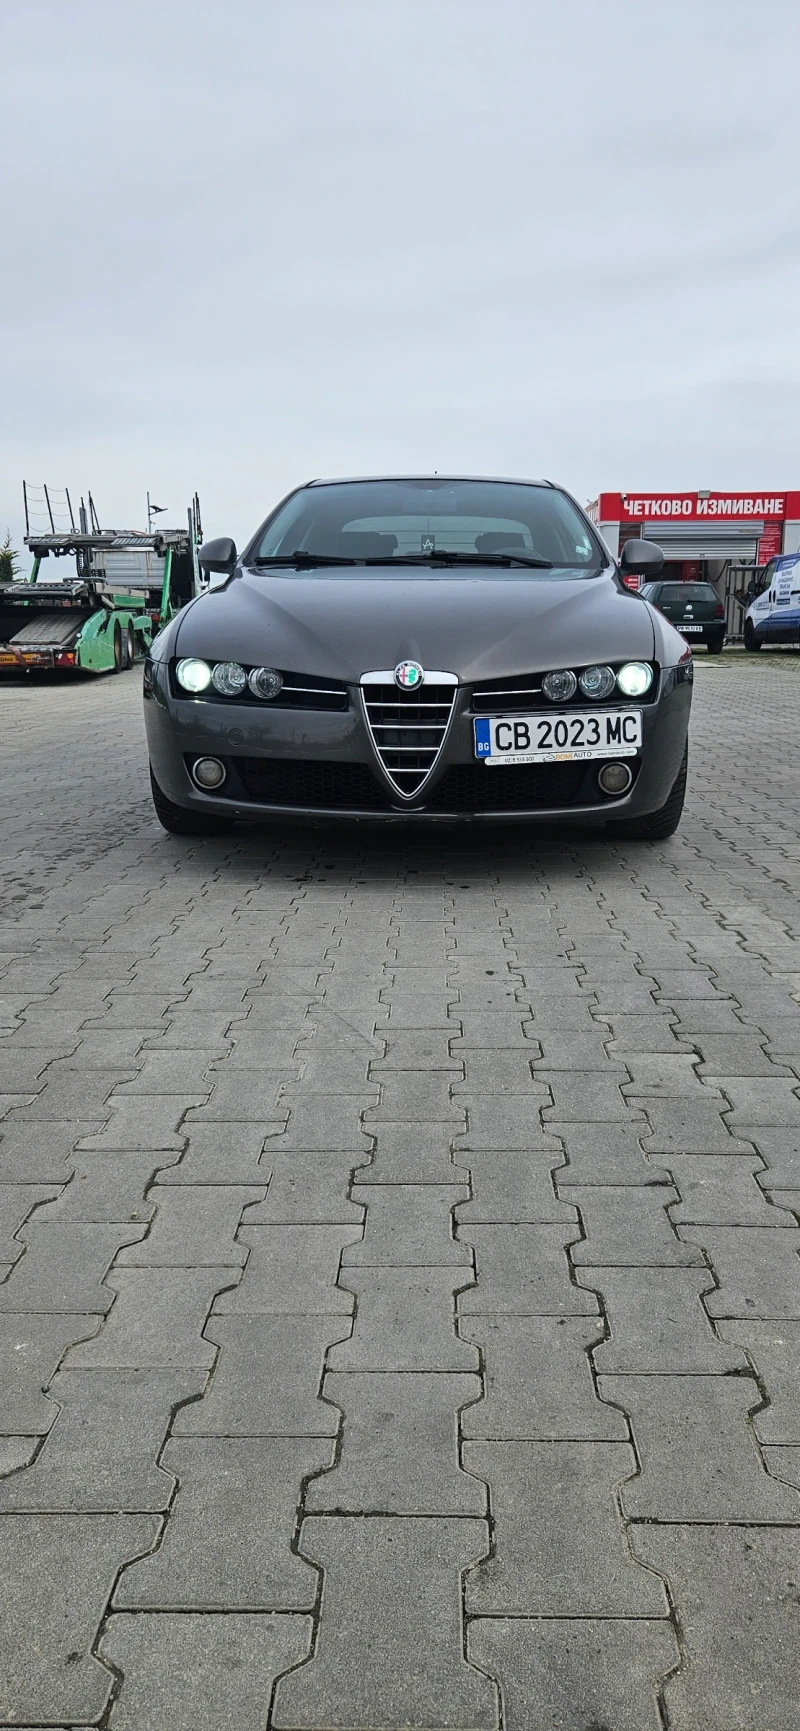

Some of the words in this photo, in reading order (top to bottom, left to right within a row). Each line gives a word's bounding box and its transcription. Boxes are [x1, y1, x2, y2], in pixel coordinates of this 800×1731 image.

[624, 499, 692, 516] ЧЕТКОВО
[696, 498, 784, 515] ИЗМИВАНЕ
[495, 722, 531, 751] CB
[537, 719, 601, 749] 2023
[606, 716, 638, 745] MC
[477, 743, 490, 752] BG
